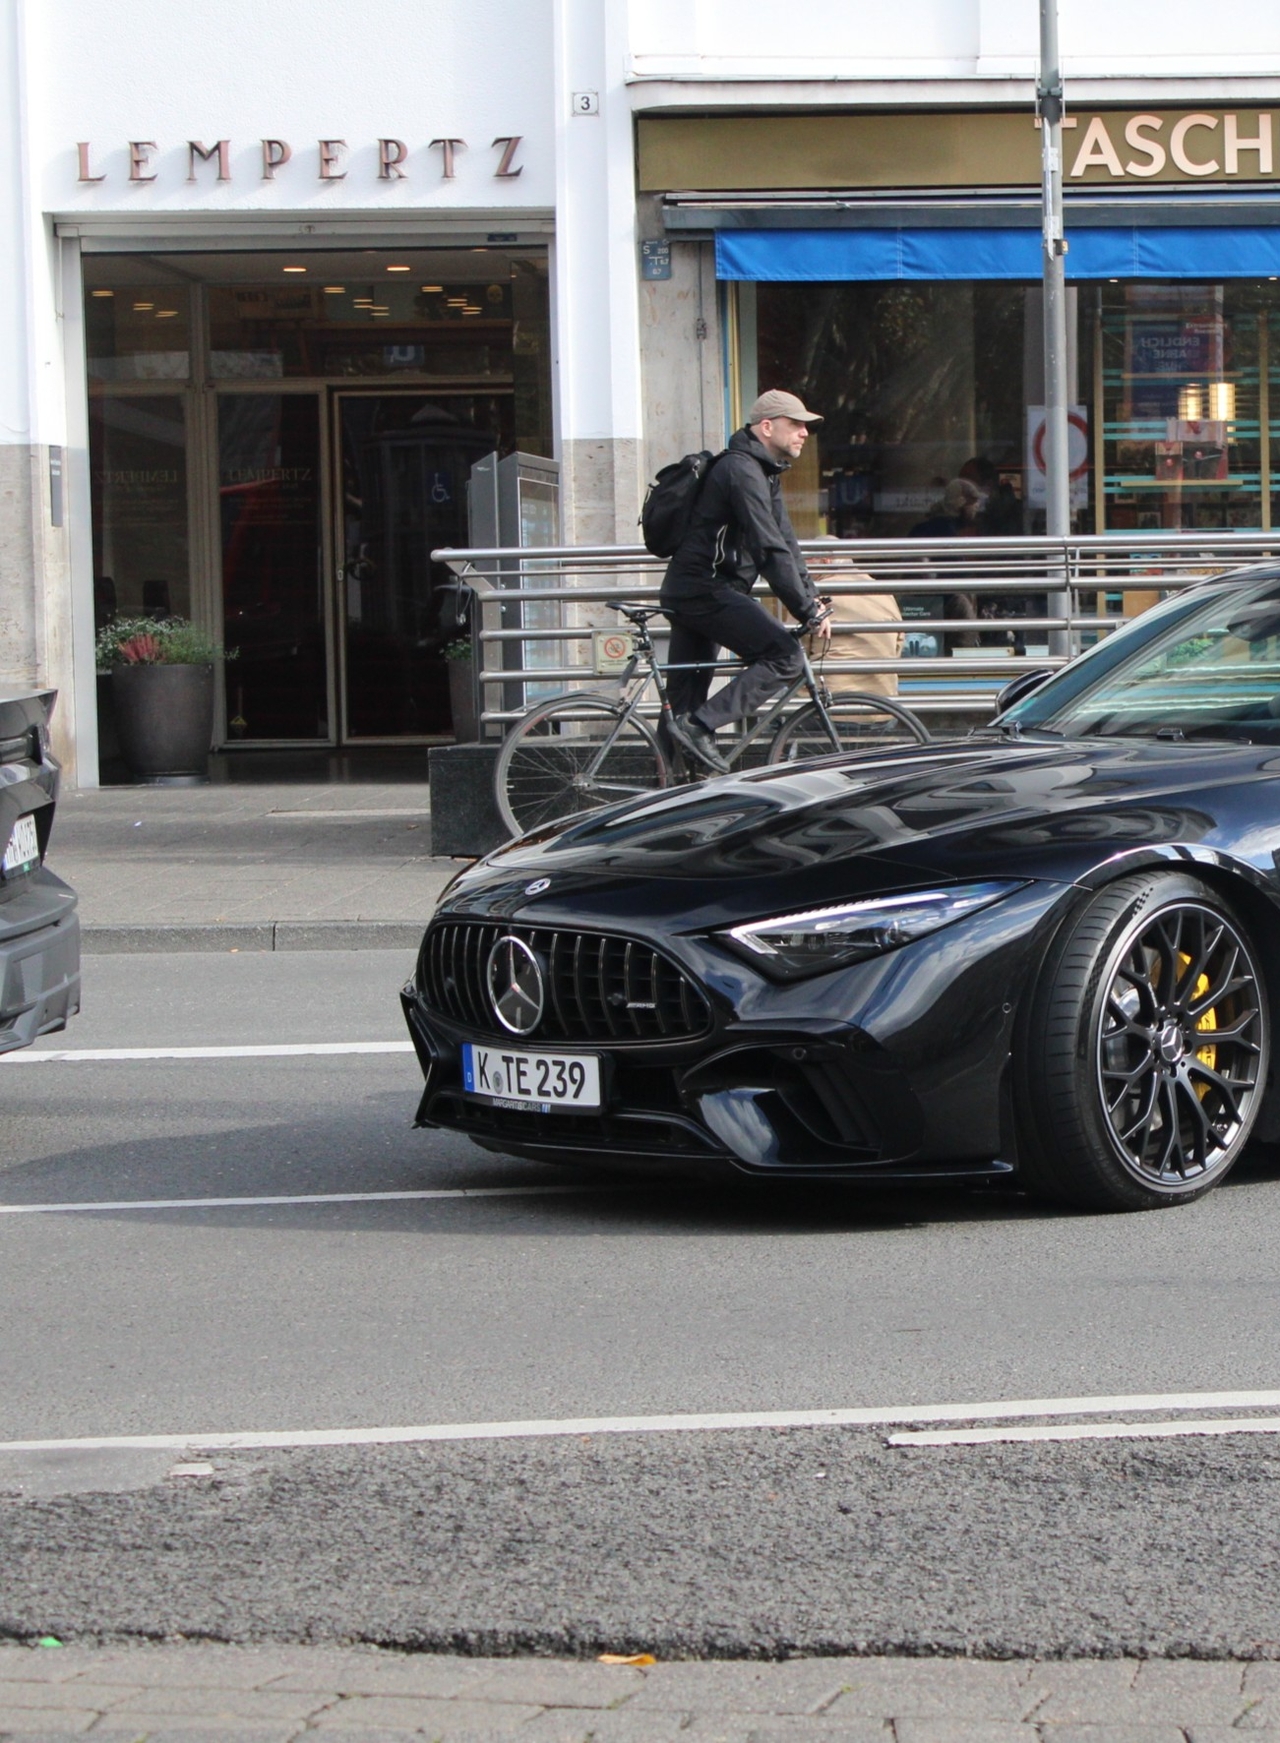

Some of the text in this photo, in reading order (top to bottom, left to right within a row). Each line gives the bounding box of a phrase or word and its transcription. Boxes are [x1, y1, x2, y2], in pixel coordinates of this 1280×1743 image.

[580, 96, 591, 111] 3
[76, 135, 524, 182] LEMPERTZ
[229, 467, 312, 482] LEMPERTZ
[478, 1051, 490, 1089] K
[501, 1055, 532, 1096] TE
[535, 1059, 586, 1099] 239
